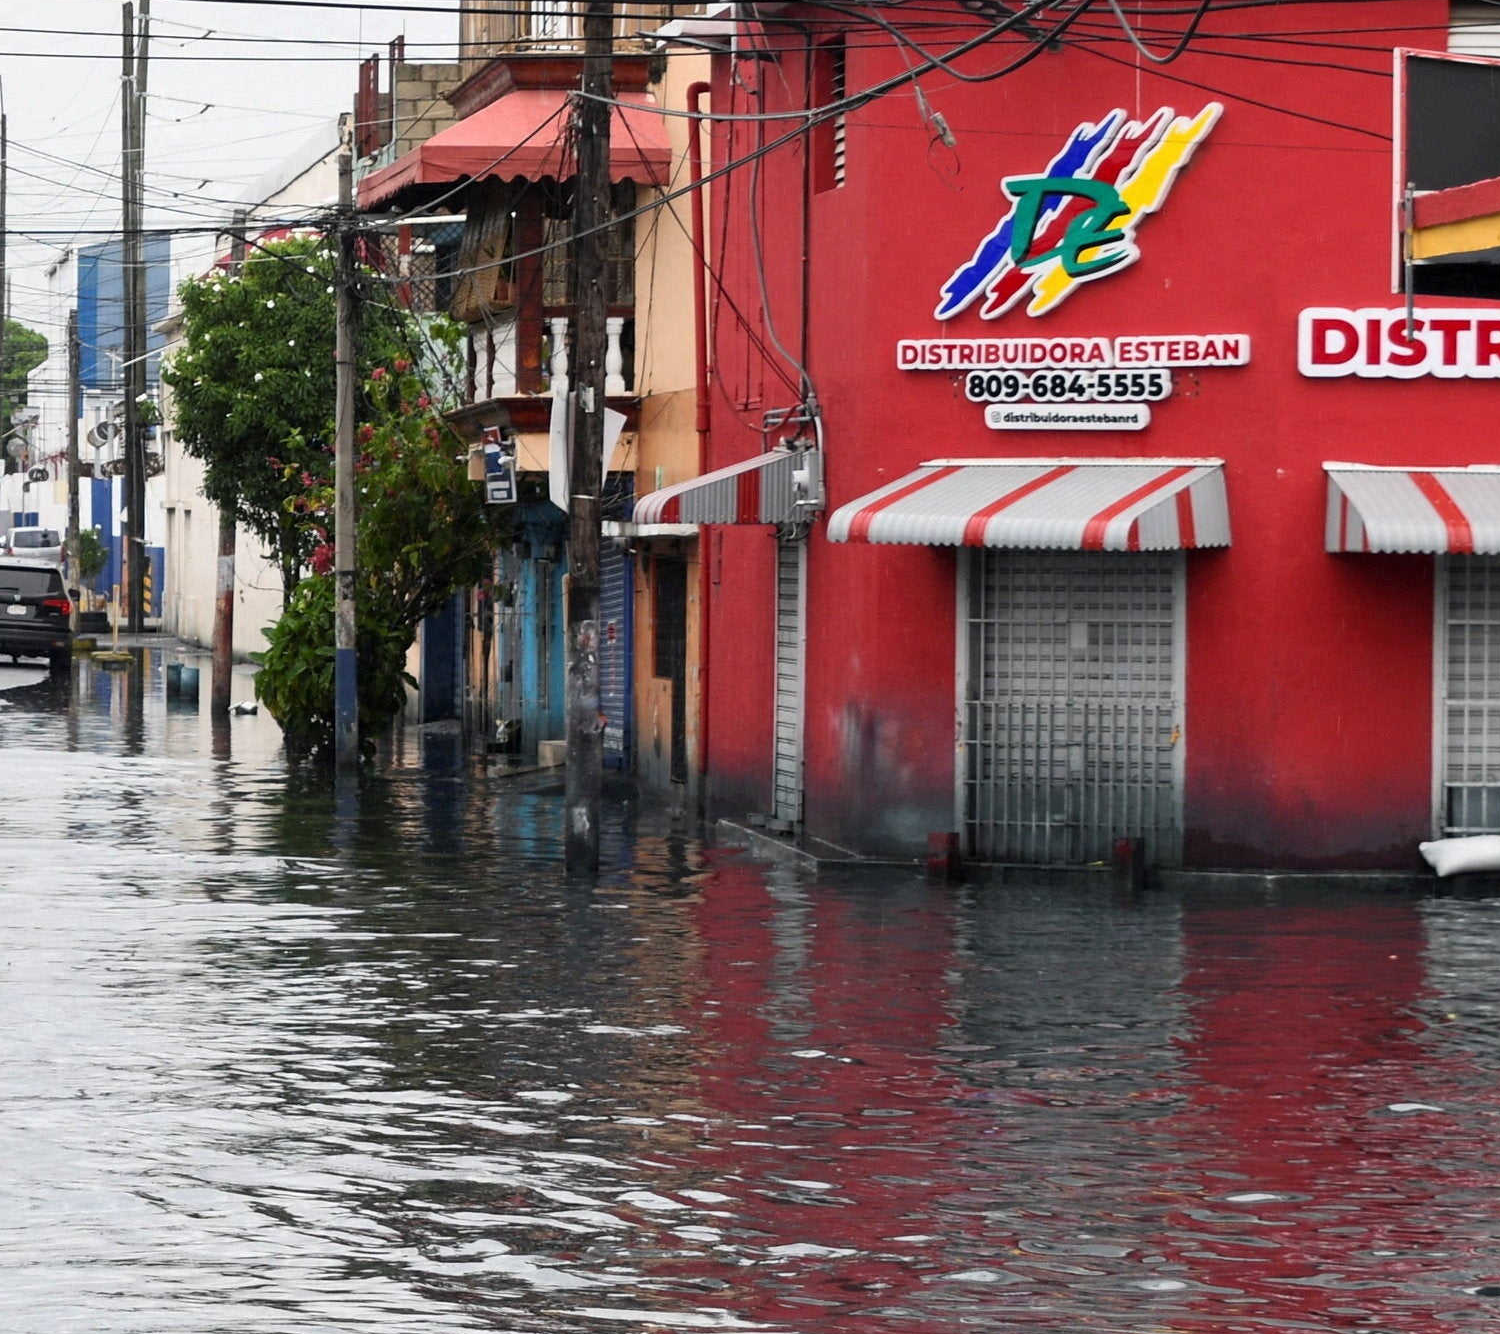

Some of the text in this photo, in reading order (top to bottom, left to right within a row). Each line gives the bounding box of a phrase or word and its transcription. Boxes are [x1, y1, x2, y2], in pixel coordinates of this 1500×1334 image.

[901, 339, 1240, 365] DISTRIBUIDORA ESTEBAN
[967, 373, 1164, 399] 809-684-5555
[1003, 411, 1139, 425] distribuidoraestebanrd
